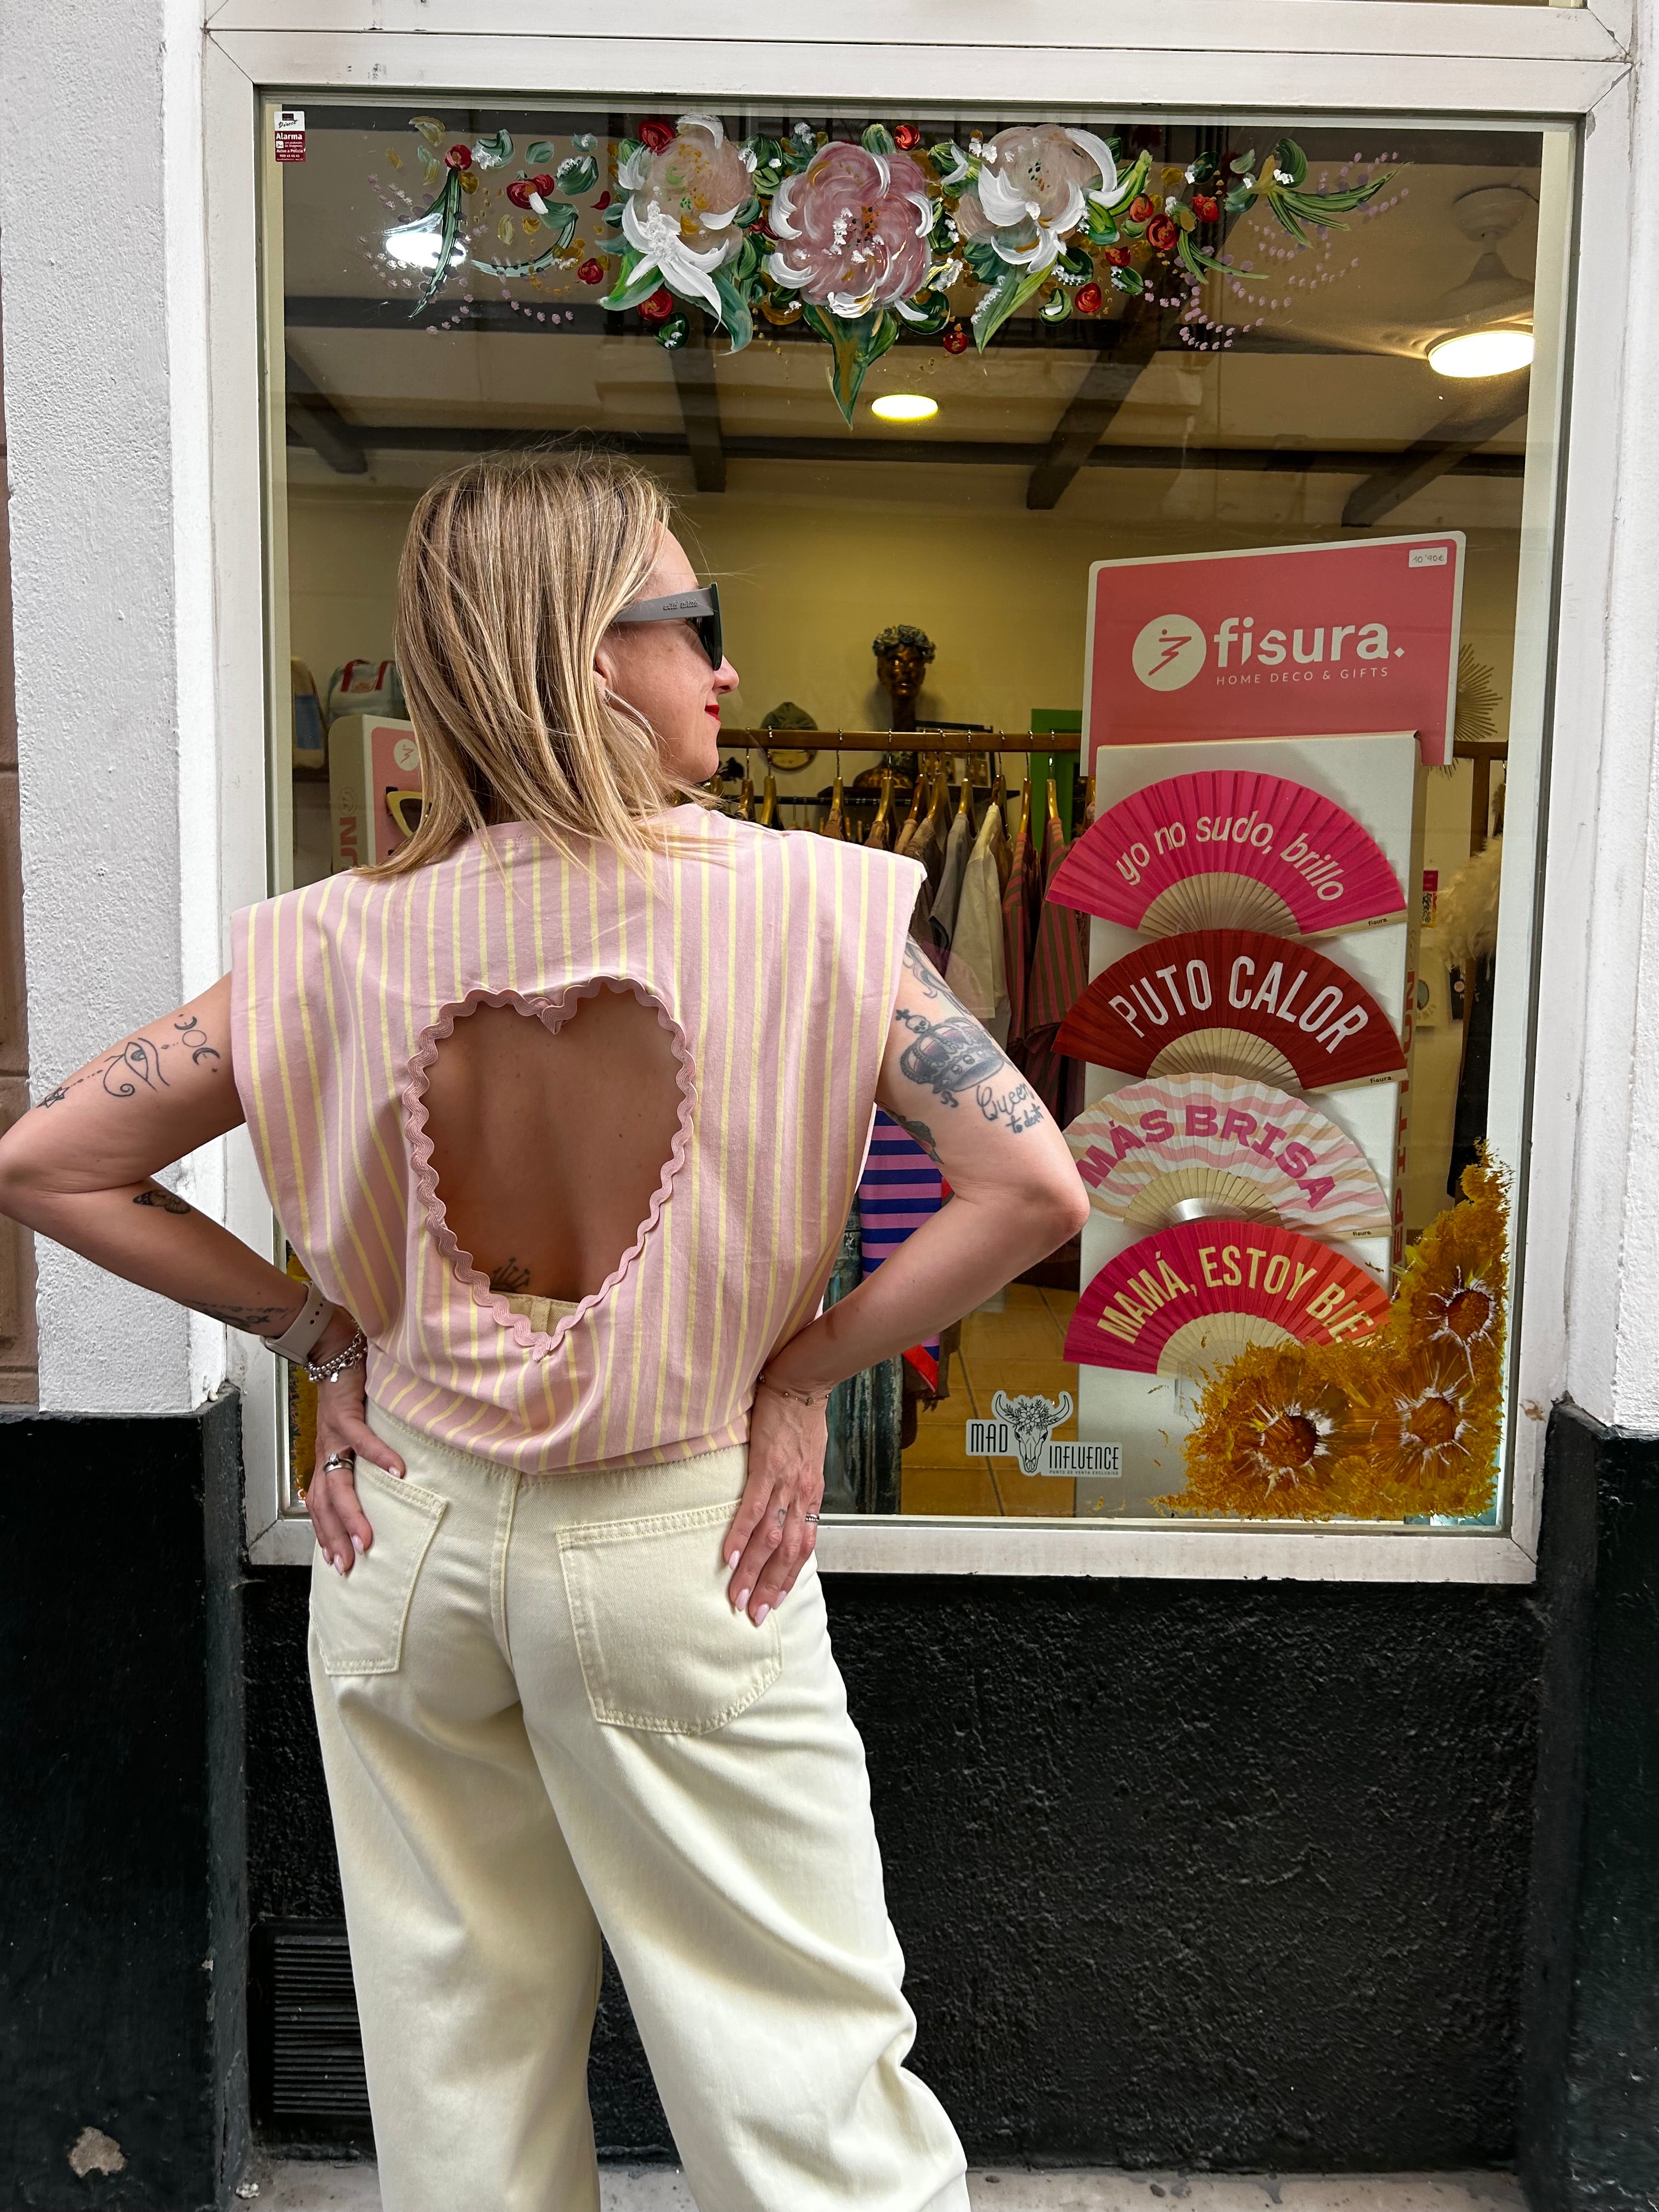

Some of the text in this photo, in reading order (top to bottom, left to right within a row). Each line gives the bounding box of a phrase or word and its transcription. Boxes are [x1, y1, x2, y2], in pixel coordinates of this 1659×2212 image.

[1214, 616, 1404, 668] fisura.
[1216, 667, 1389, 685] HOME DECO & GIFTS
[1116, 810, 1344, 901] yo no sudo, brillo
[1108, 956, 1368, 1054] PUTO CALOR
[977, 1084, 1034, 1121] Queen
[1005, 1115, 1023, 1133] to
[1076, 1105, 1336, 1208] MÁS BRISA
[1097, 1248, 1198, 1344] MAMÁ,
[1198, 1245, 1317, 1301] ESTOY
[970, 1423, 1008, 1453] MAD
[1049, 1446, 1119, 1470] INFLUENCE
